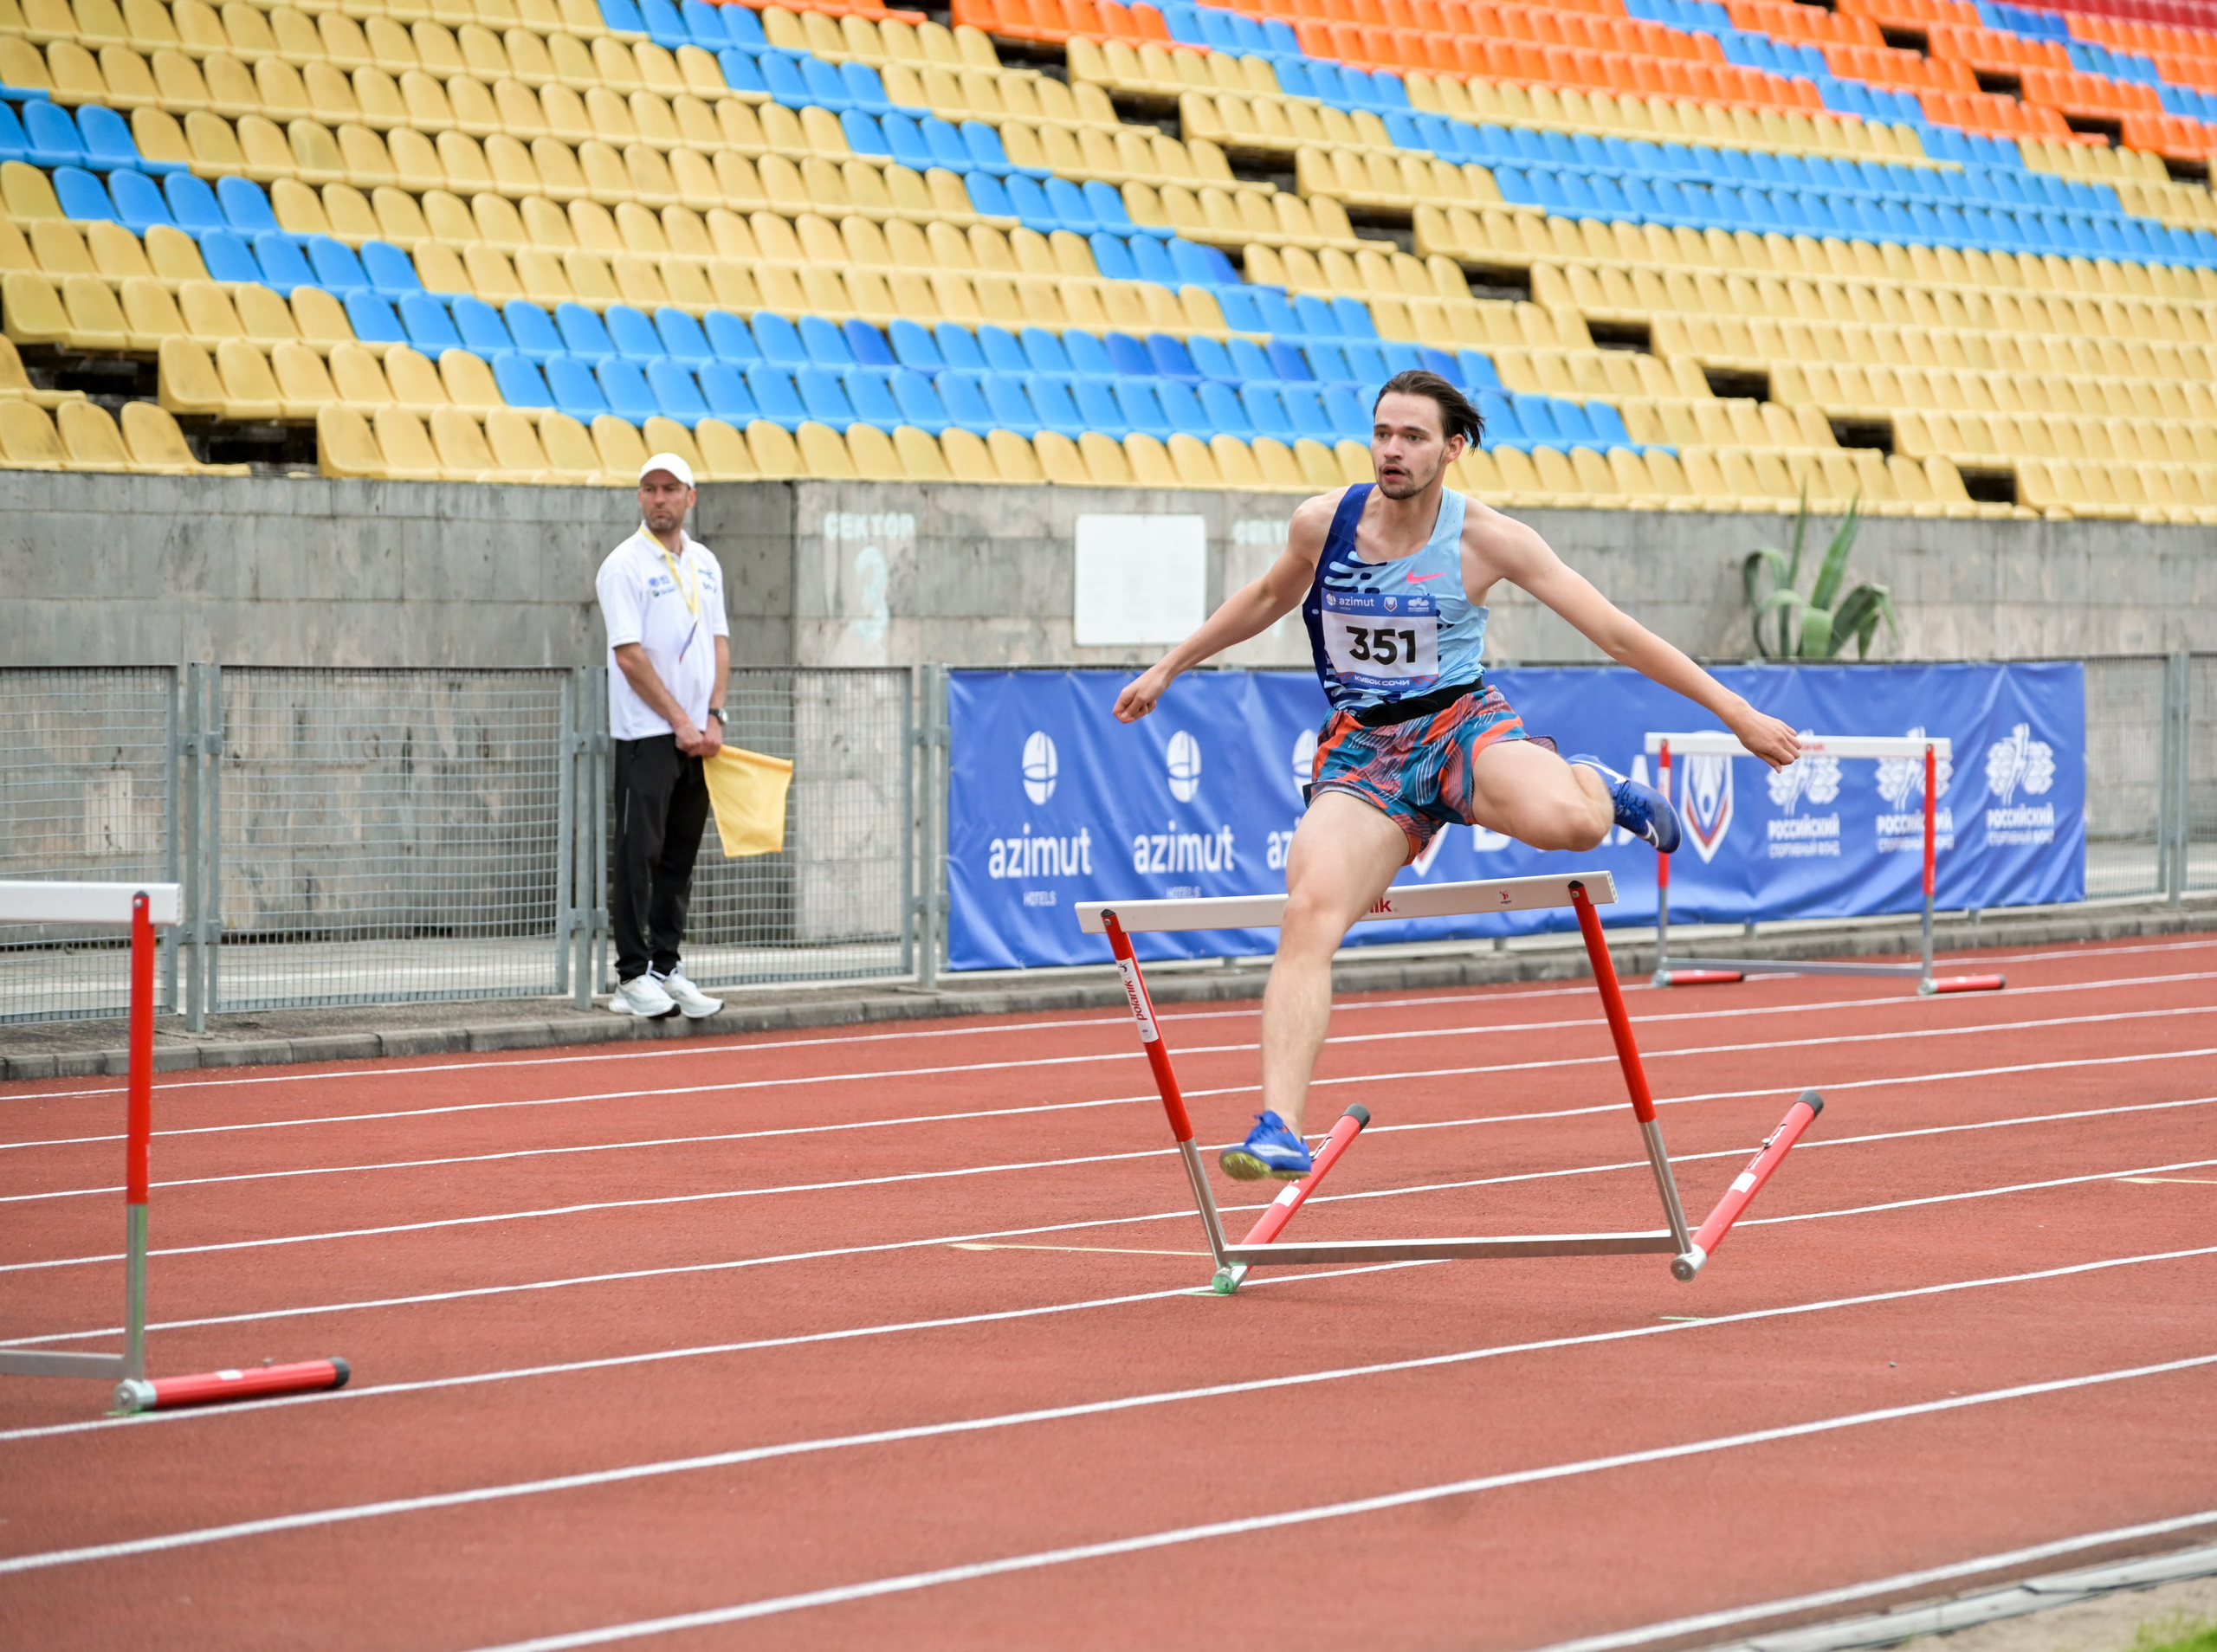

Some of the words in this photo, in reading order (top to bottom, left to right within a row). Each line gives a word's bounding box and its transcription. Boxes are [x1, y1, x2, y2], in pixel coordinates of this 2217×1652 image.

[824, 511, 915, 540] СЕКТОР
[1339, 596, 1374, 607] azimut
[1346, 625, 1416, 665] 351
[1354, 674, 1381, 686] КУБОК
[1768, 812, 1840, 840] РОССИЙСКИЙ
[1987, 802, 2055, 829] РОССИЙСКИЙ
[988, 822, 1092, 880] azimut
[1133, 819, 1235, 874] azimut
[1023, 890, 1057, 907] HOTELS
[1124, 979, 1148, 1022] polanik
